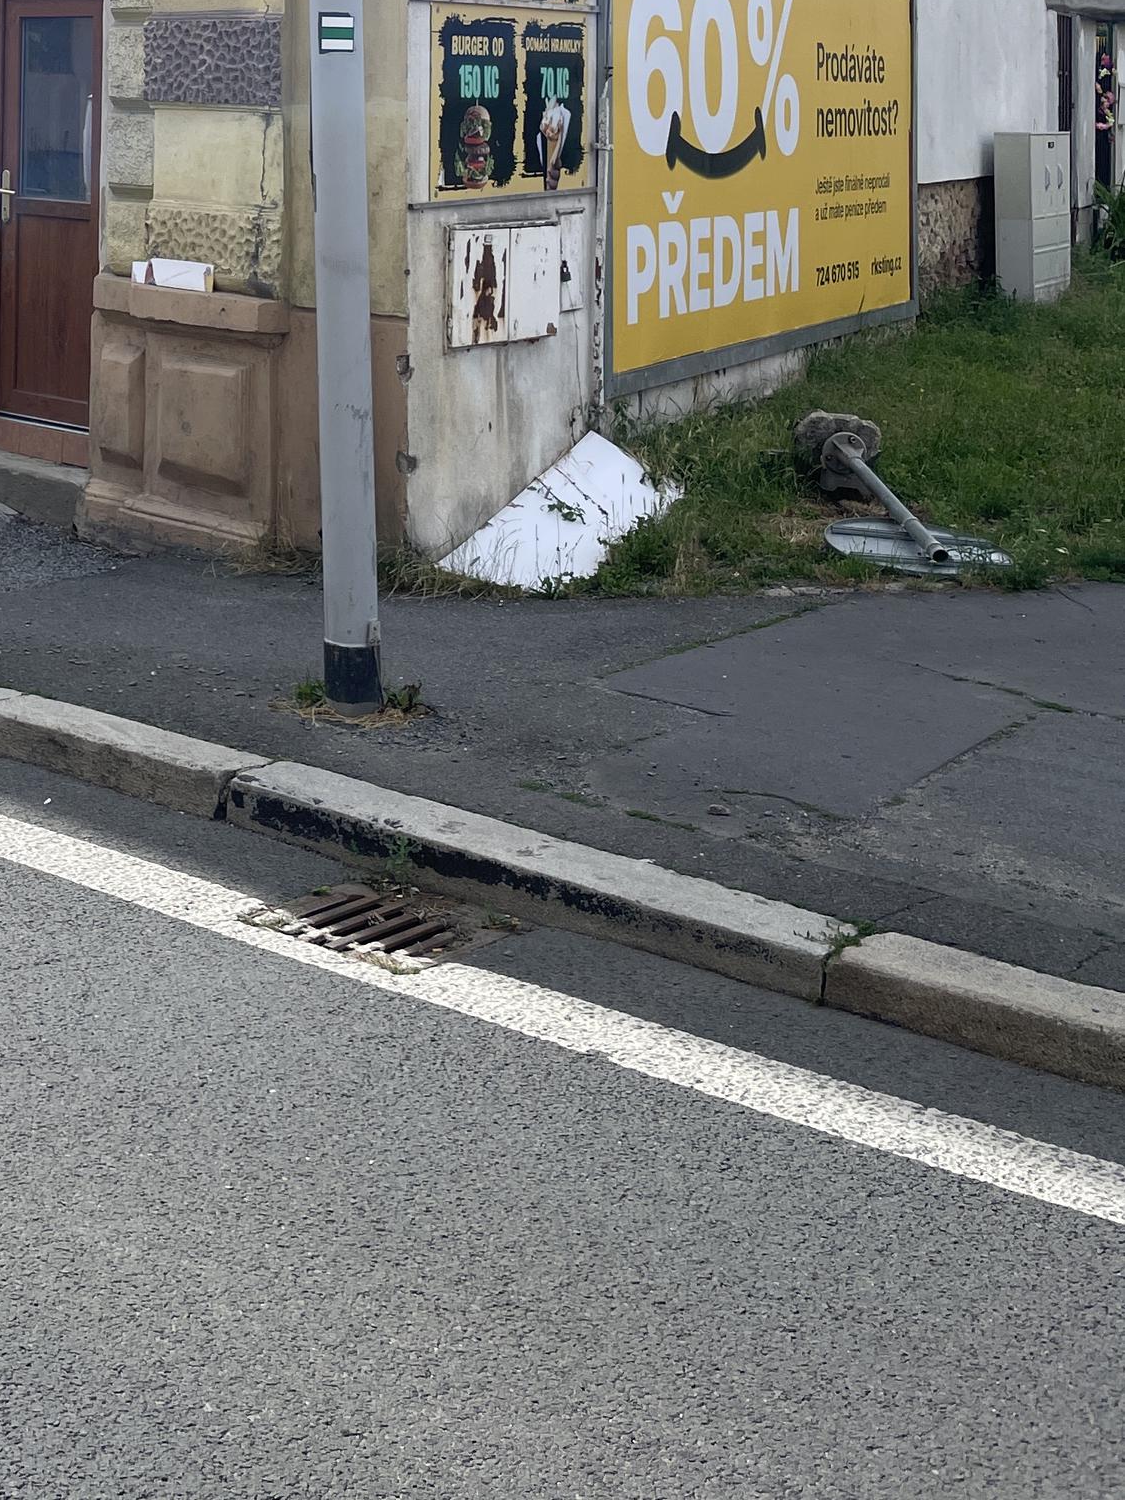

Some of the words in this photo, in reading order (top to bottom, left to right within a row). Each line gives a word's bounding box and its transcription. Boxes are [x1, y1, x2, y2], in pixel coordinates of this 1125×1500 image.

[451, 35, 489, 56] BURGER
[492, 36, 505, 57] OD
[815, 41, 885, 87] Prodáváte
[458, 64, 481, 98] 150
[483, 65, 499, 98] KC
[540, 67, 554, 99] 70
[556, 67, 570, 99] KC
[815, 98, 899, 140] nemovitost?
[625, 190, 800, 327] PŘEDEM
[816, 265, 830, 287] 724
[831, 263, 845, 284] 670
[847, 260, 860, 280] 515
[871, 255, 902, 277] rksting.cz
